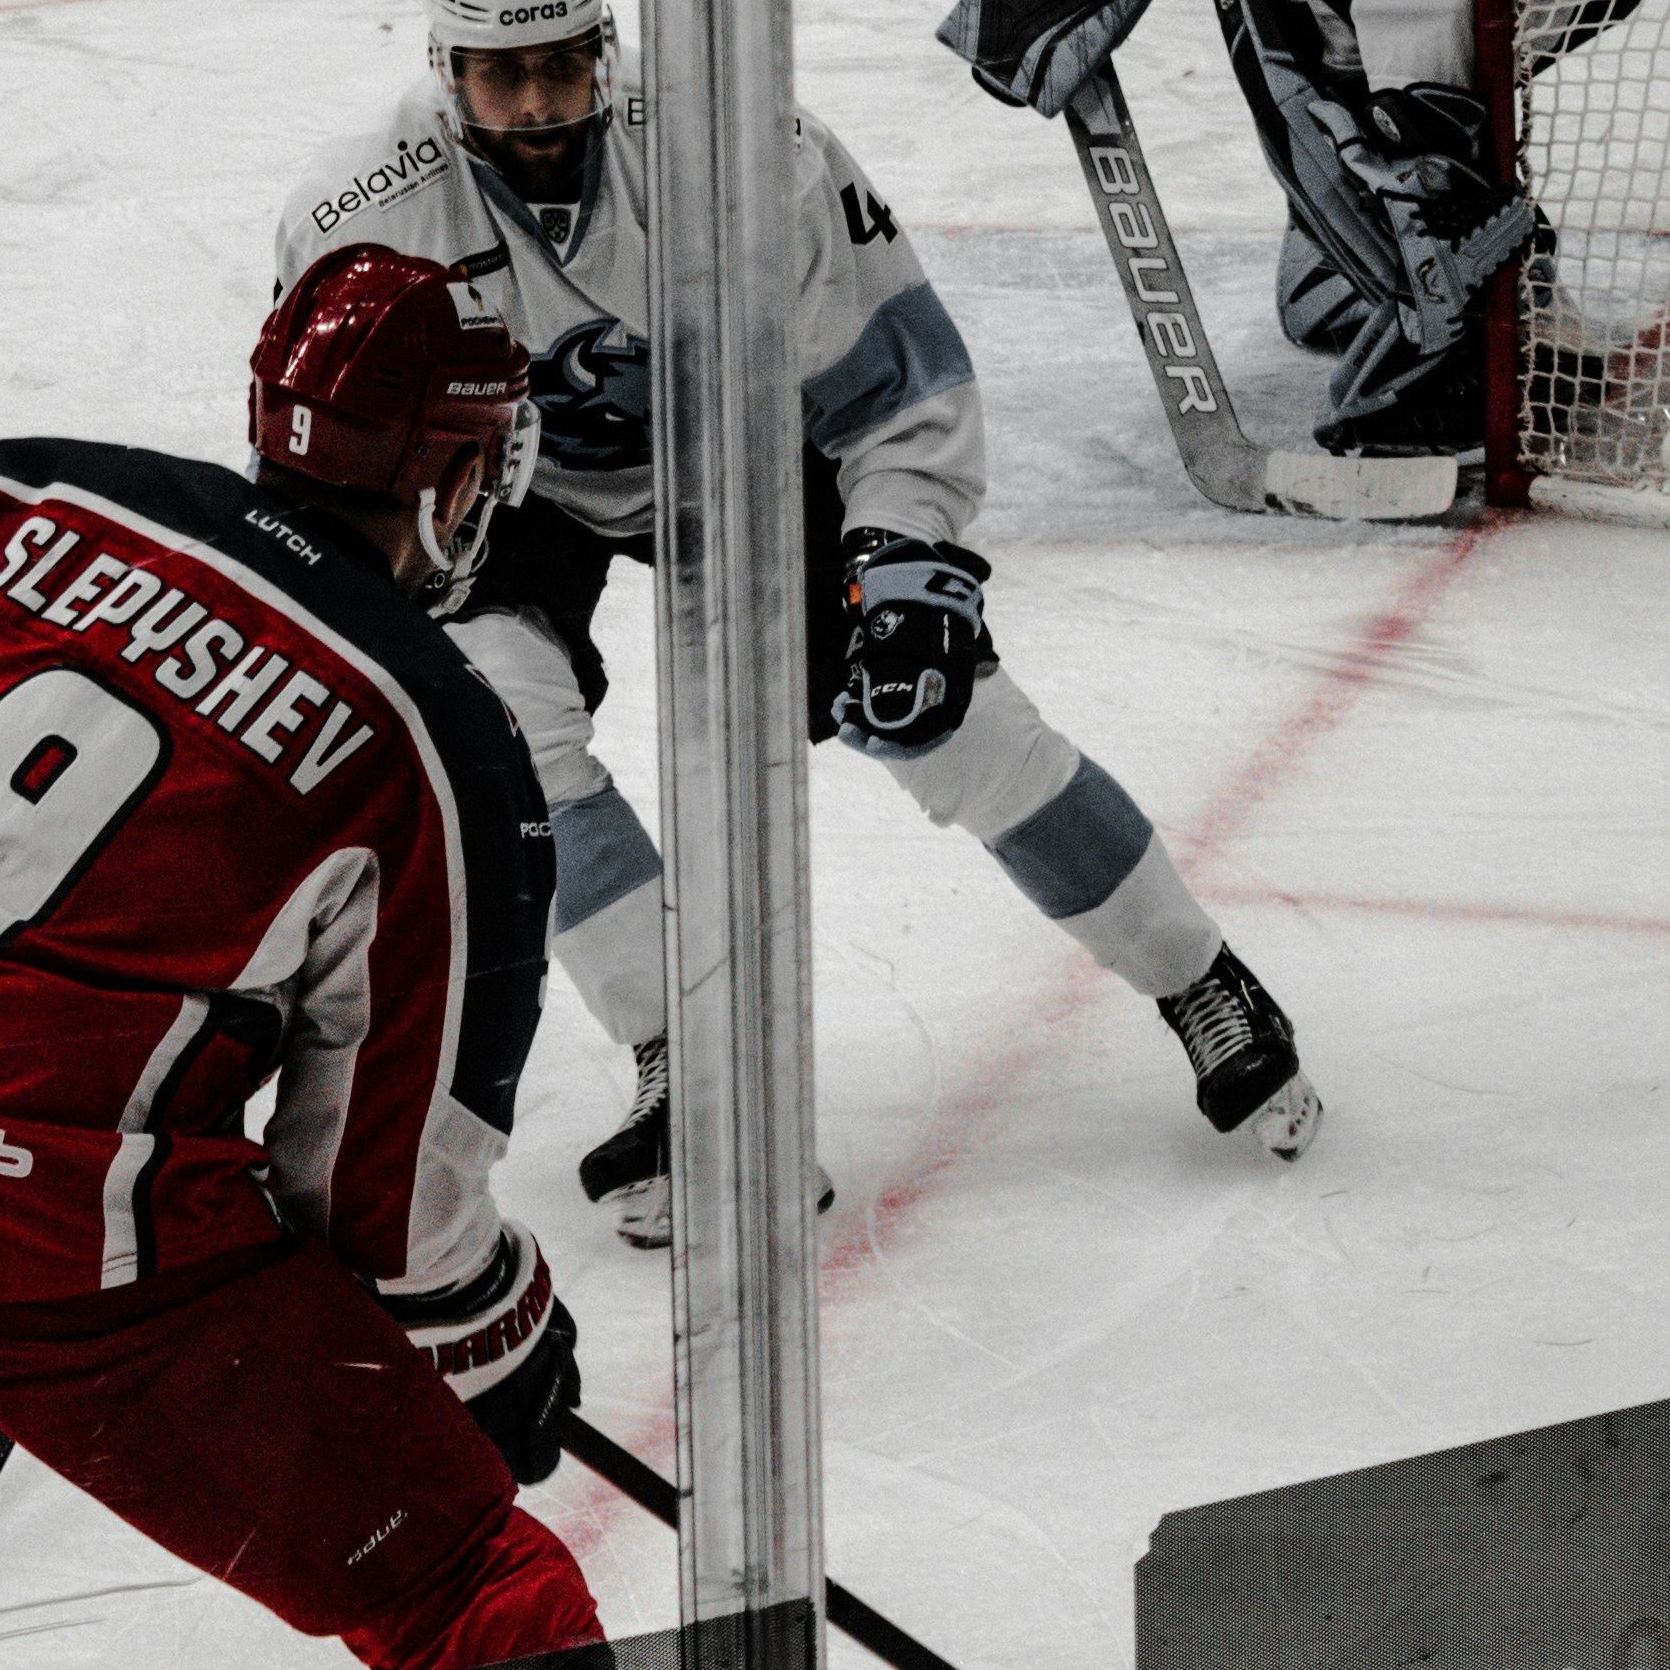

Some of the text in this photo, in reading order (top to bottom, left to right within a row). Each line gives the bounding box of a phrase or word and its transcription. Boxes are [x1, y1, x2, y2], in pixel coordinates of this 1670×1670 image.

[499, 1, 568, 26] согаз
[311, 138, 442, 234] Belavia
[840, 182, 898, 245] 4
[1088, 145, 1218, 416] BAUER
[445, 380, 508, 397] BAUER
[288, 403, 313, 456] 9
[870, 681, 914, 698] CCM
[520, 821, 552, 838] РОС
